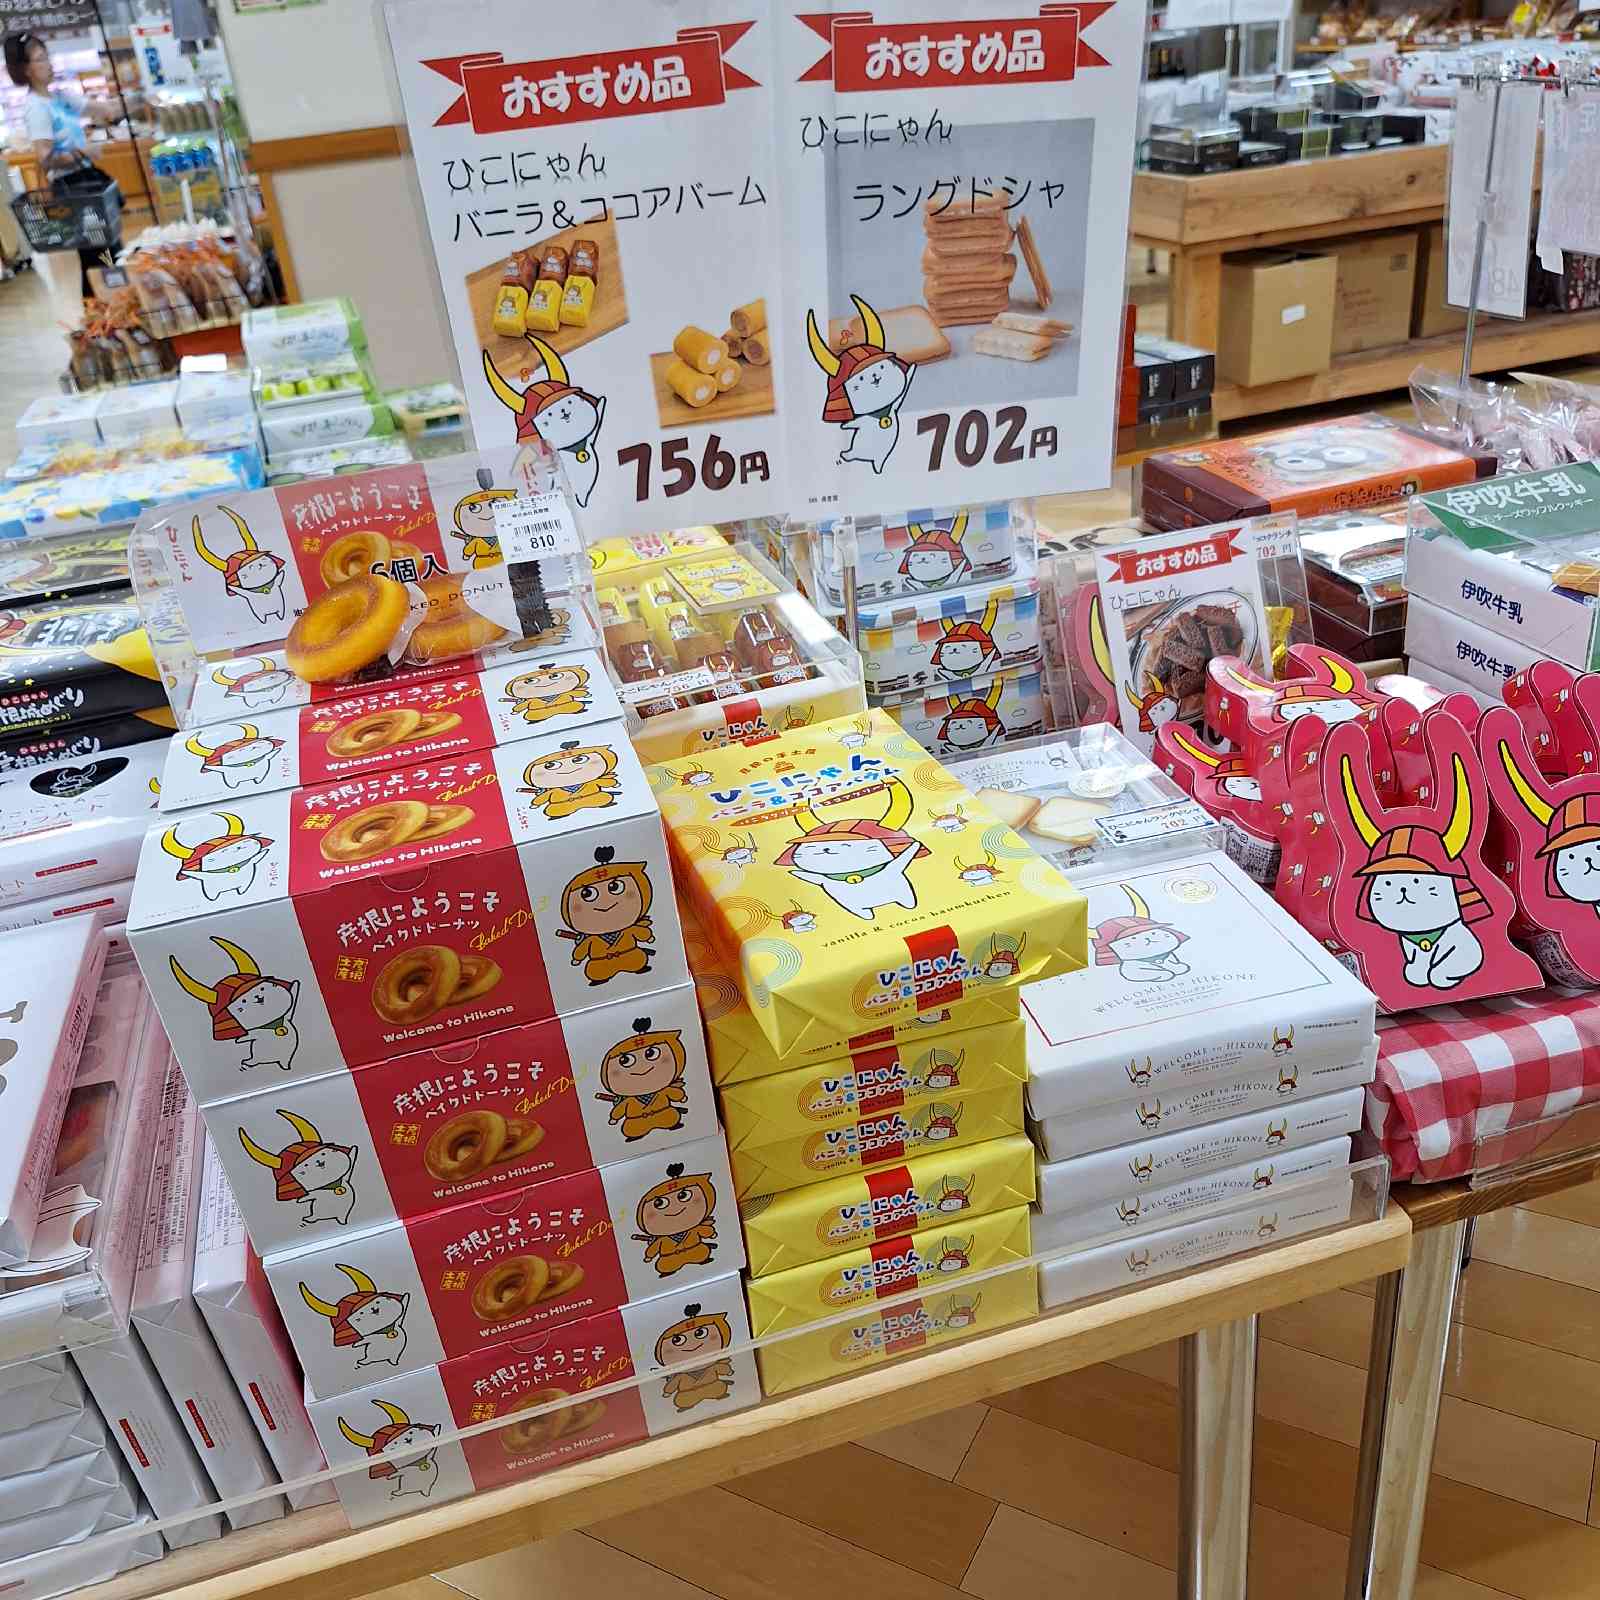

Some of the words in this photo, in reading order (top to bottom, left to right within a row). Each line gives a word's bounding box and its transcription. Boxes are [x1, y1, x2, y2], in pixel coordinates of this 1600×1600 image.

[865, 29, 1045, 80] おすすめ品
[501, 56, 692, 119] おすすめ品
[800, 109, 952, 148] ひこにゃん
[442, 143, 606, 191] ひこにゃん
[454, 176, 767, 241] バニラ&ココアバーム
[853, 176, 1065, 221] ラングドシャ
[916, 405, 1058, 473] 702円
[617, 434, 770, 502] 756円
[1447, 471, 1587, 515] 伊吹牛乳
[530, 534, 555, 549] 810
[1136, 544, 1217, 577] おすすめ品
[410, 598, 439, 611] KED
[448, 582, 505, 602] DONUT
[1111, 585, 1181, 610] ひこにゃん
[1461, 579, 1523, 624] 伊吹牛乳
[325, 750, 400, 772] Welcome
[400, 745, 414, 759] to
[415, 737, 470, 755] Hikone
[304, 762, 484, 811] 彦根にようこそ
[709, 754, 883, 804] ひこにゃん
[319, 855, 396, 881] Welcome
[397, 850, 416, 865] to
[419, 835, 483, 858] Hikone
[336, 890, 501, 948] 彦根にようこそ
[879, 950, 967, 987] ひこにゃん
[1191, 973, 1258, 985] HIKONE
[383, 1022, 445, 1044] Welcome
[446, 1016, 462, 1028] to
[463, 1004, 514, 1024] Hikone
[823, 1062, 908, 1092] ひこにゃん
[1153, 1047, 1207, 1074] WELCOME
[1226, 1040, 1269, 1051] HIKONE
[392, 1061, 545, 1116] 彦根にようこそ
[825, 1115, 907, 1144] ひこにゃん
[432, 1177, 491, 1199] Welcome
[491, 1172, 507, 1184] to
[508, 1160, 556, 1180] Hikone
[840, 1188, 920, 1219] ひこにゃん
[442, 1208, 585, 1264] 彦根にようこそ
[843, 1250, 921, 1281] ひこにゃん
[479, 1316, 533, 1338] Welcome
[534, 1311, 549, 1322] to
[549, 1298, 594, 1318] Hikone
[472, 1345, 607, 1397] 彦根にようこそ
[505, 1449, 557, 1471] Welcome
[559, 1444, 573, 1456] to
[572, 1431, 616, 1452] Hikone
